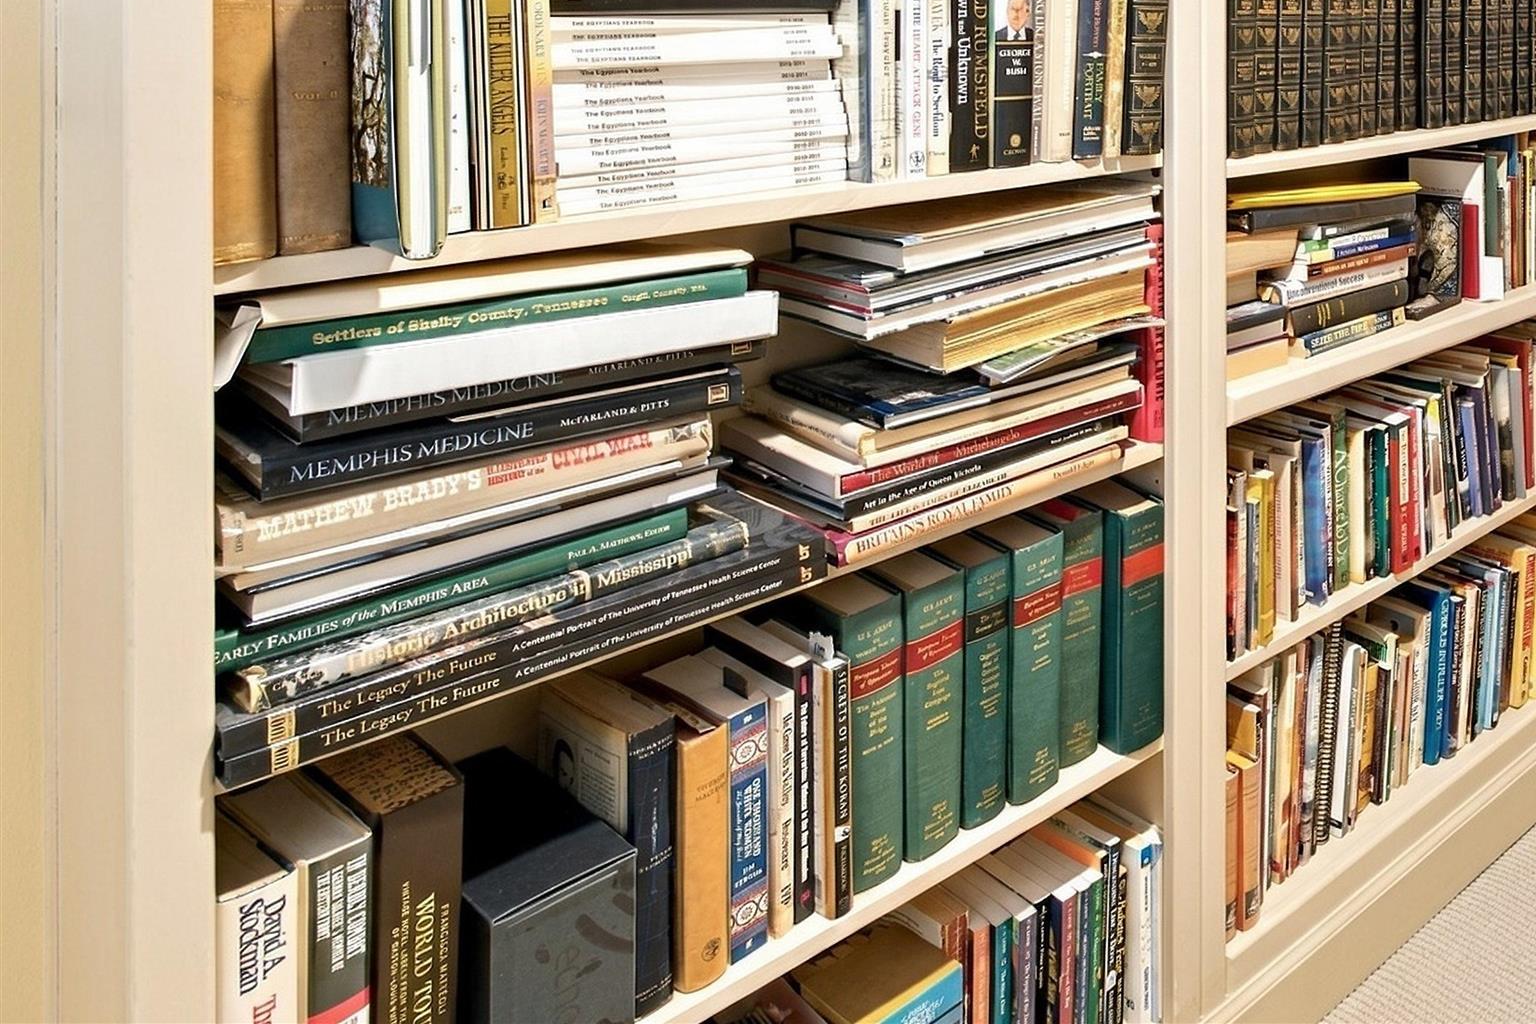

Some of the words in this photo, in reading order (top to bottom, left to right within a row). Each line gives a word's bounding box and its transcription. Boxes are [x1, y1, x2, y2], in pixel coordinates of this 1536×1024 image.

[488, 13, 511, 39] THE
[489, 41, 514, 85] KILLER
[931, 57, 943, 82] Road
[957, 36, 971, 105] Unknown
[998, 48, 1031, 57] GEORGE
[1005, 67, 1028, 76] BUSH
[973, 23, 988, 139] RUMSFELD
[1082, 62, 1094, 120] PORTRAIT
[490, 88, 515, 137] ANGELS
[932, 95, 944, 137] Serfdom
[1286, 279, 1338, 300] Unconventional
[1338, 272, 1365, 288] Success
[312, 327, 382, 346] Settlers
[386, 320, 405, 334] of
[408, 315, 464, 334] Shelby
[468, 306, 529, 324] County,
[532, 296, 609, 314] Tennessee
[1310, 333, 1333, 349] SEIZE
[1333, 328, 1350, 341] THE
[1350, 320, 1371, 336] FIRE
[326, 392, 447, 427] MEMPHIS
[451, 370, 564, 403] MEDICINE
[560, 407, 627, 429] McFARLAND
[640, 398, 670, 412] PITTS
[288, 443, 414, 483] MEMPHIS
[415, 422, 534, 460] MEDICINE
[550, 443, 604, 471] CIVIL
[606, 429, 654, 459] WAR
[893, 459, 926, 478] World
[955, 429, 1020, 457] Michelangelo
[487, 468, 526, 487] HISTORY
[863, 499, 877, 512] Art
[888, 490, 902, 503] the
[903, 484, 918, 497] Age
[929, 473, 953, 491] Queen
[953, 464, 982, 482] Victoria
[256, 498, 376, 543] MATHEW
[383, 467, 483, 513] BRADY'S
[855, 515, 926, 554] BRITAIN'S
[927, 499, 971, 528] ROYAL
[971, 483, 1016, 515] FAMILY
[266, 619, 339, 650] FAMILIES
[342, 614, 357, 629] of
[358, 608, 378, 622] the
[380, 587, 448, 617] MEMPHIS
[450, 576, 490, 597] AREA
[346, 629, 436, 673] Historic
[443, 584, 568, 642] Architecture
[597, 542, 694, 590] Mississippi
[521, 627, 566, 651] Centennial
[567, 617, 598, 635] Portrait
[608, 608, 623, 620] The
[623, 595, 661, 617] University
[671, 581, 708, 599] Tennessee
[709, 573, 732, 590] Health
[732, 565, 759, 582] Science
[759, 557, 782, 571] Center
[524, 655, 569, 677] Centennial
[569, 643, 600, 661] Portrait
[611, 634, 626, 646] The
[626, 620, 664, 641] University
[674, 604, 710, 623] Tennessee
[711, 596, 734, 611] Health
[735, 587, 760, 602] Science
[760, 579, 783, 593] Center
[318, 698, 353, 718] The
[357, 679, 412, 706] Legacy
[414, 668, 446, 686] The
[448, 651, 498, 674] Future
[836, 670, 848, 718] SECRETS
[320, 726, 356, 747] The
[361, 707, 414, 735] Legacy
[417, 695, 449, 713] The
[452, 677, 501, 701] Future
[751, 777, 762, 801] ONE
[839, 775, 850, 821] KORAN
[751, 802, 762, 858] THOUSAND
[239, 897, 264, 997] Stockman
[263, 894, 287, 954] David
[413, 891, 436, 978] WORLD
[438, 902, 450, 964] FRANCISCA
[262, 955, 287, 982] A.
